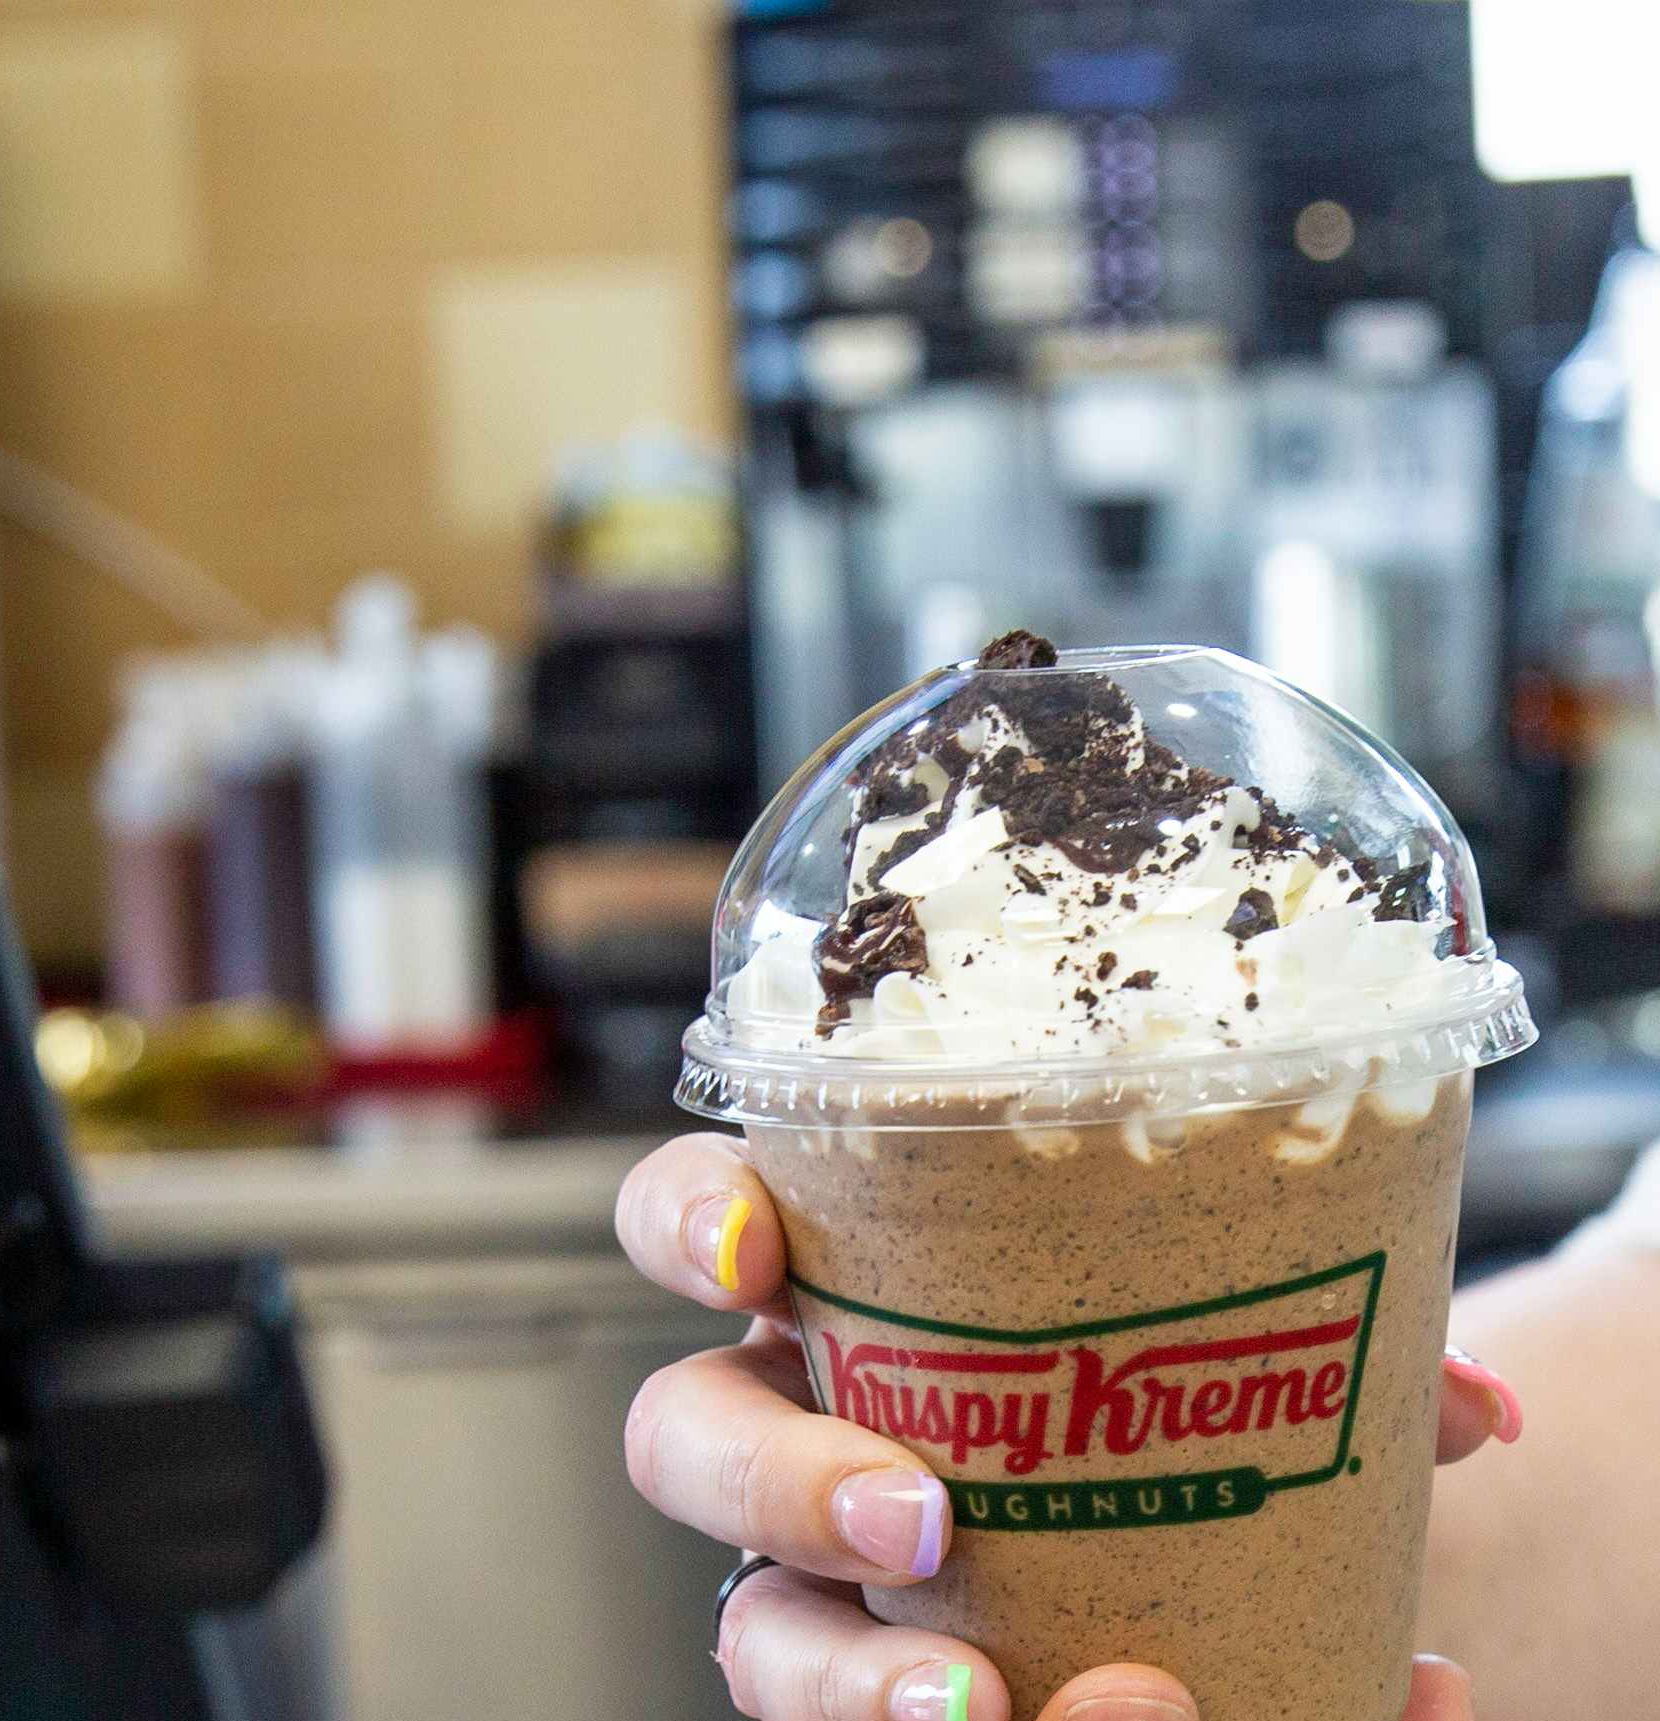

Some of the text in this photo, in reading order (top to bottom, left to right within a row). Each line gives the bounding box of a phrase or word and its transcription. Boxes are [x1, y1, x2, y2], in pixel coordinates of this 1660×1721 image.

[821, 1313, 1360, 1475] Krispy Kreme
[968, 1480, 1236, 1520] UGHNUTS
